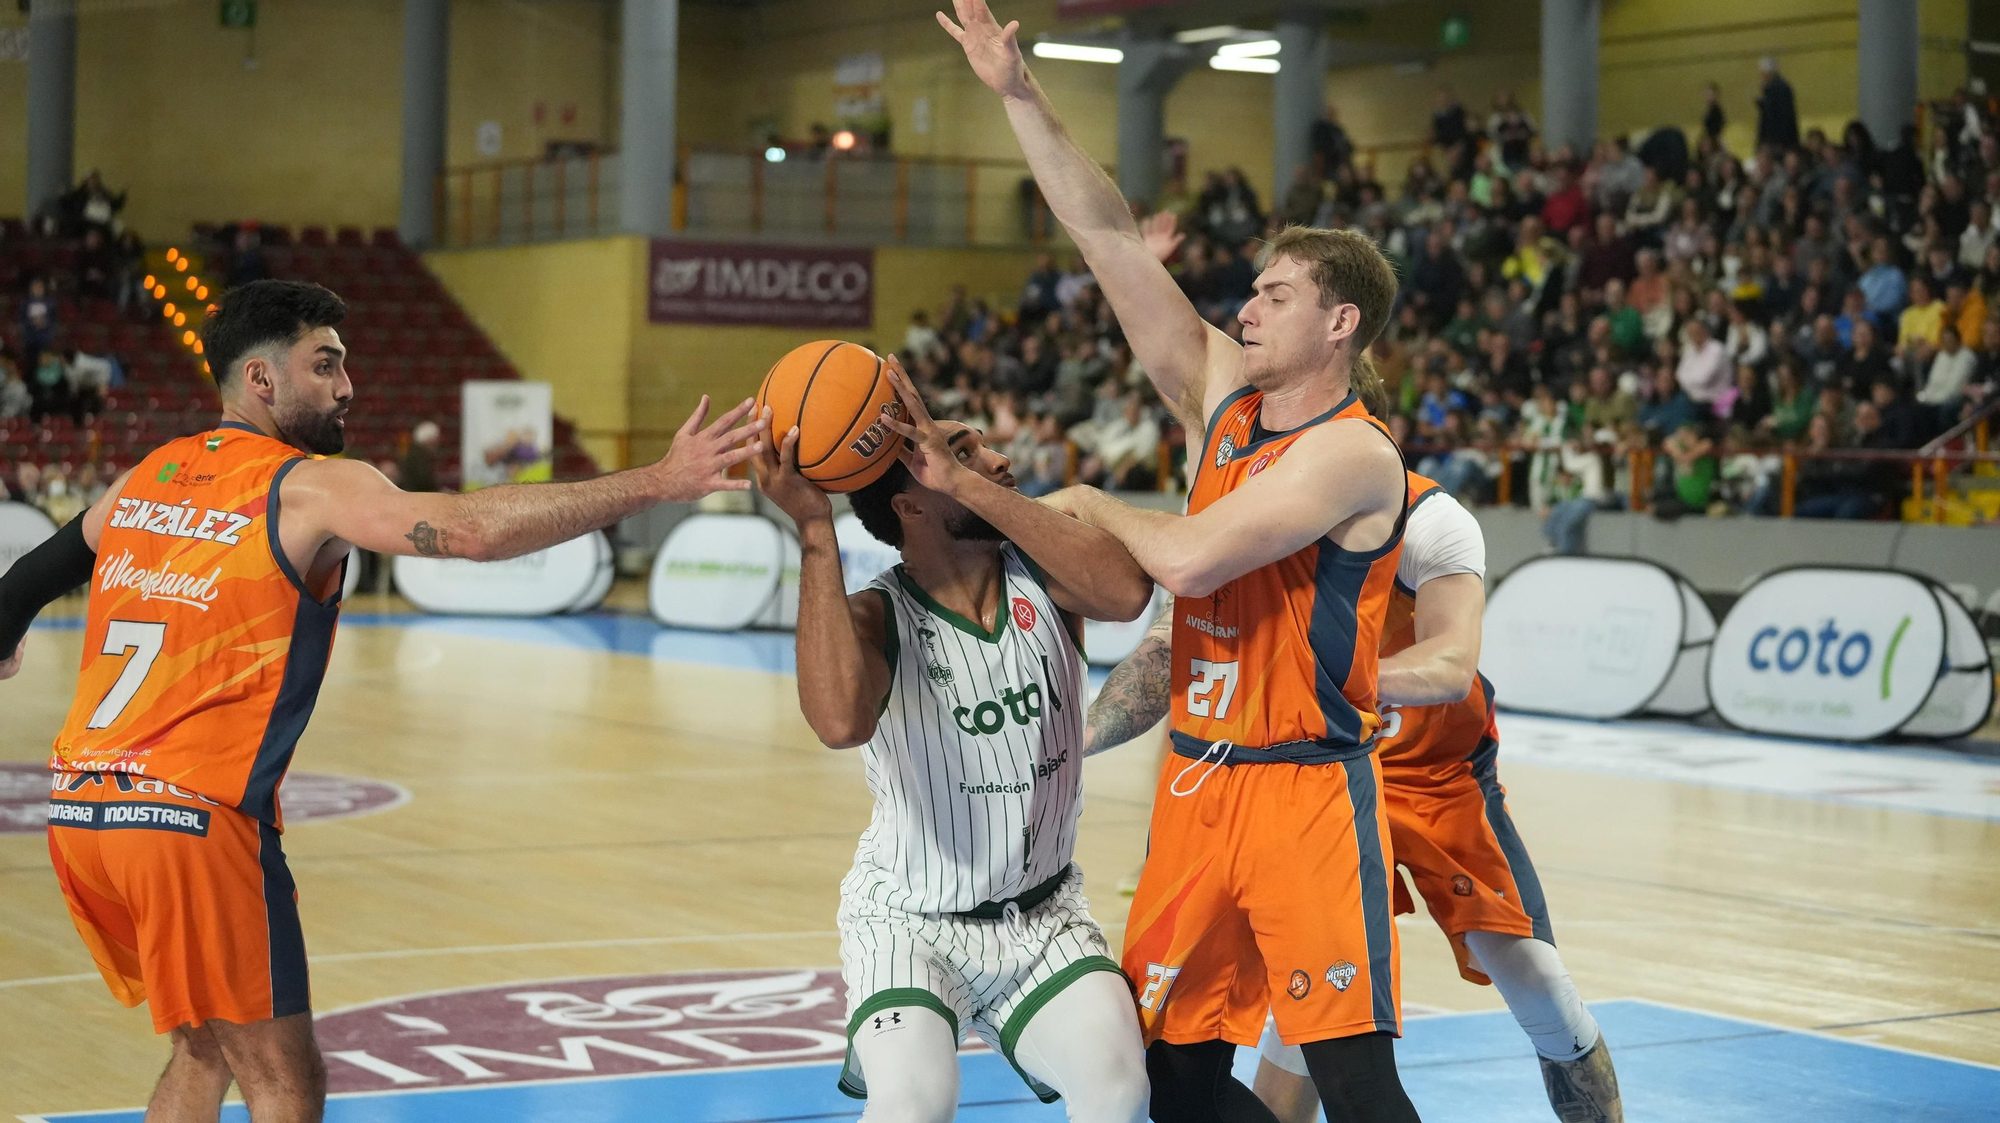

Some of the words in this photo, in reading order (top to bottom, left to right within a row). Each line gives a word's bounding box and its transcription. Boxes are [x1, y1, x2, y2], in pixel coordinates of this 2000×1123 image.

[704, 258, 868, 302] IMDECO
[110, 497, 253, 546] GONZÁLEZ
[98, 548, 222, 603] Wheyland
[86, 619, 168, 730] 7
[1748, 617, 1872, 678] coto
[953, 683, 1041, 737] coto
[1187, 657, 1239, 720] 27
[959, 781, 1031, 795] Fundación
[1139, 961, 1182, 1012] 27
[322, 1026, 849, 1084] IMD
